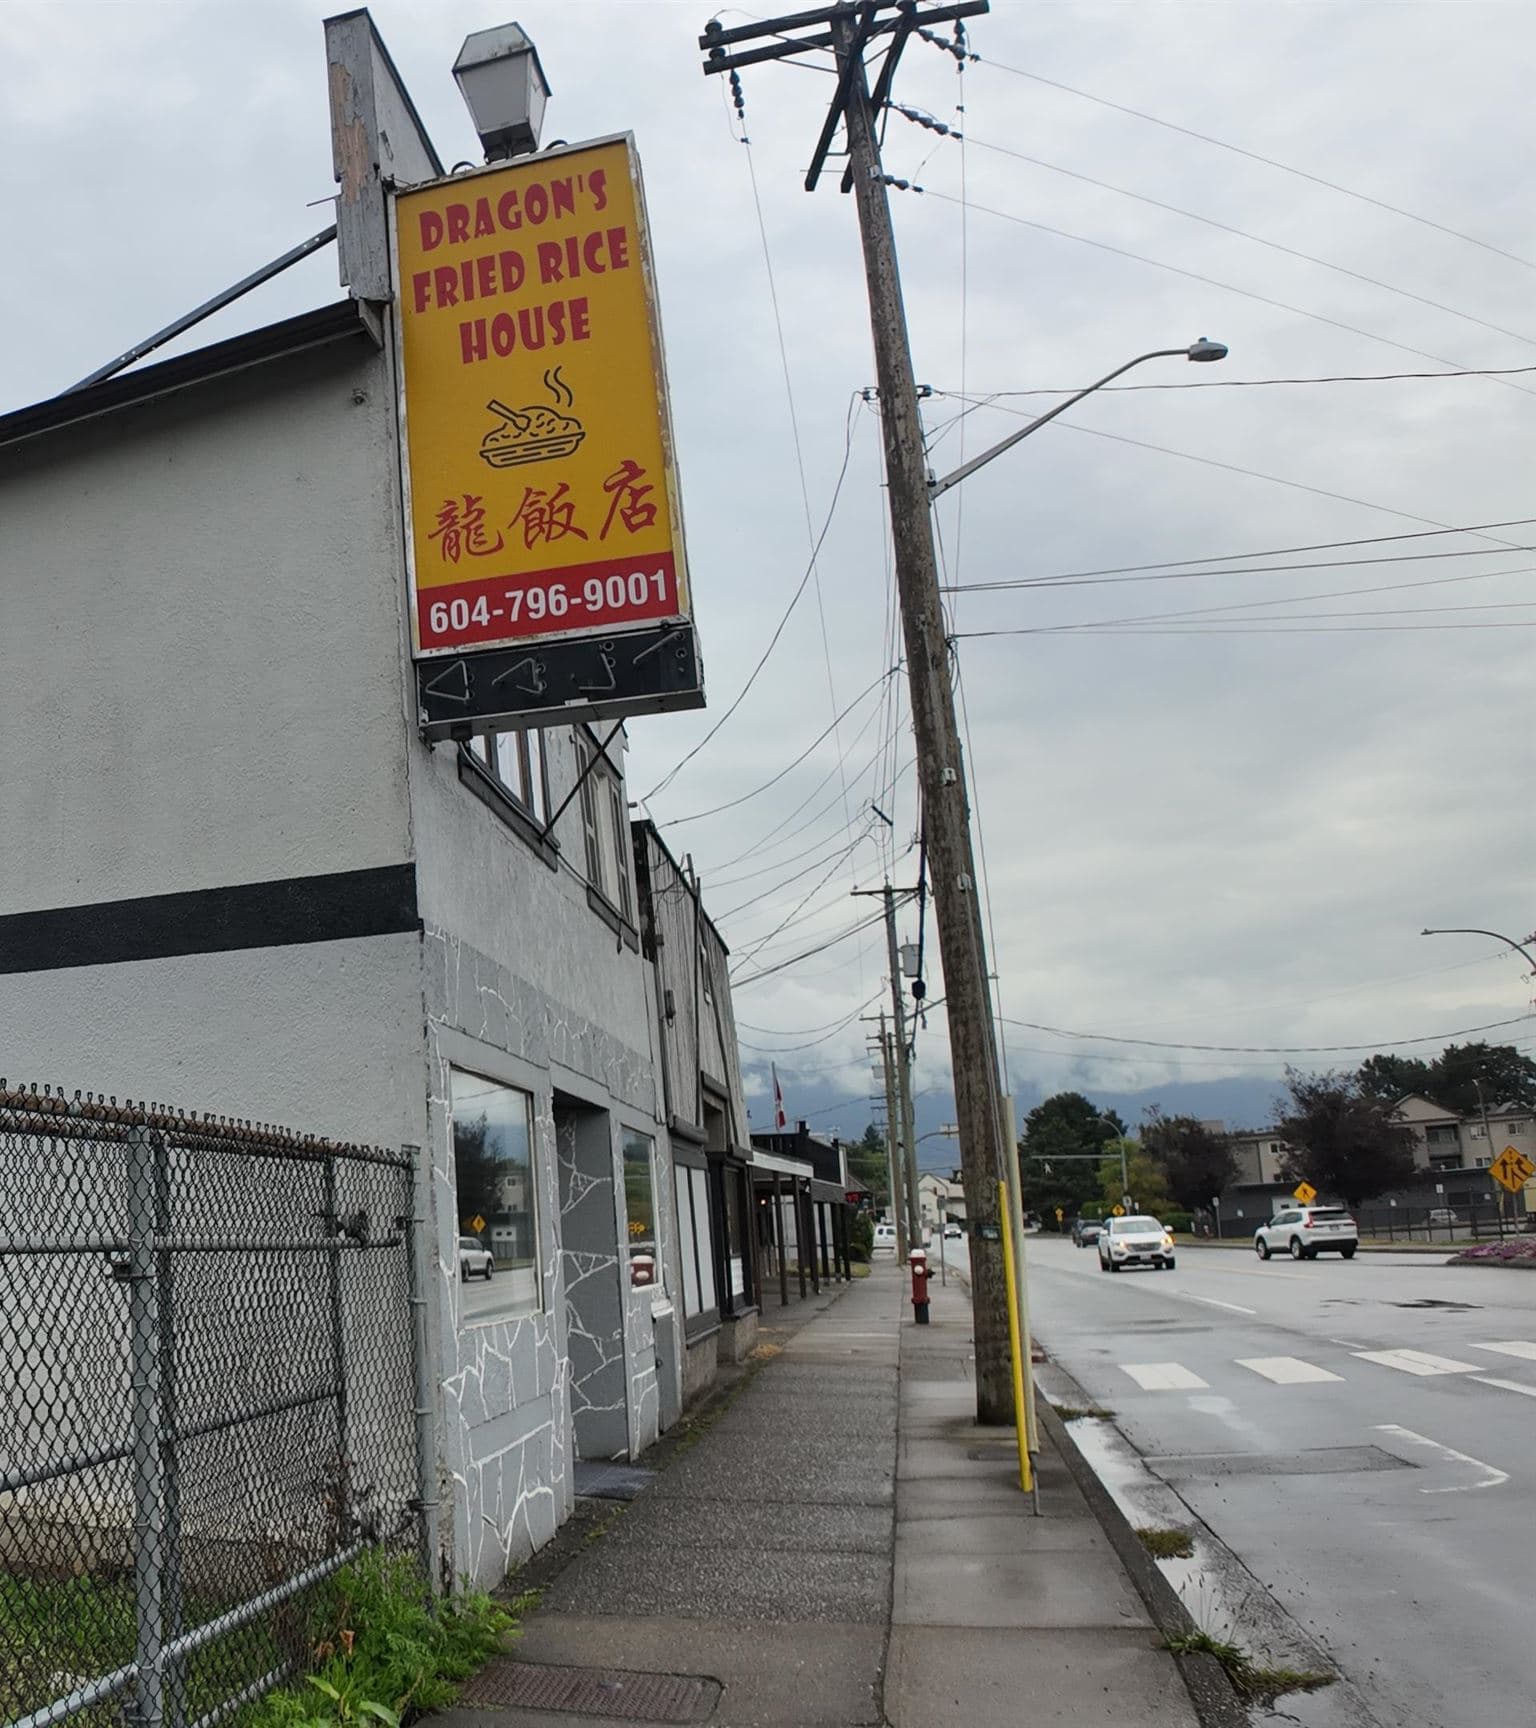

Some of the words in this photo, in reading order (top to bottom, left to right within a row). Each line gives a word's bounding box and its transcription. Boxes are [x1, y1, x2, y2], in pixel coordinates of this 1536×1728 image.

[418, 168, 607, 251] DRAGON'S
[412, 250, 525, 314] FRIED
[537, 226, 629, 285] RICE
[459, 296, 591, 364] HOUSE
[427, 459, 658, 564] 龍飯店
[429, 569, 667, 634] 604-796-9001
